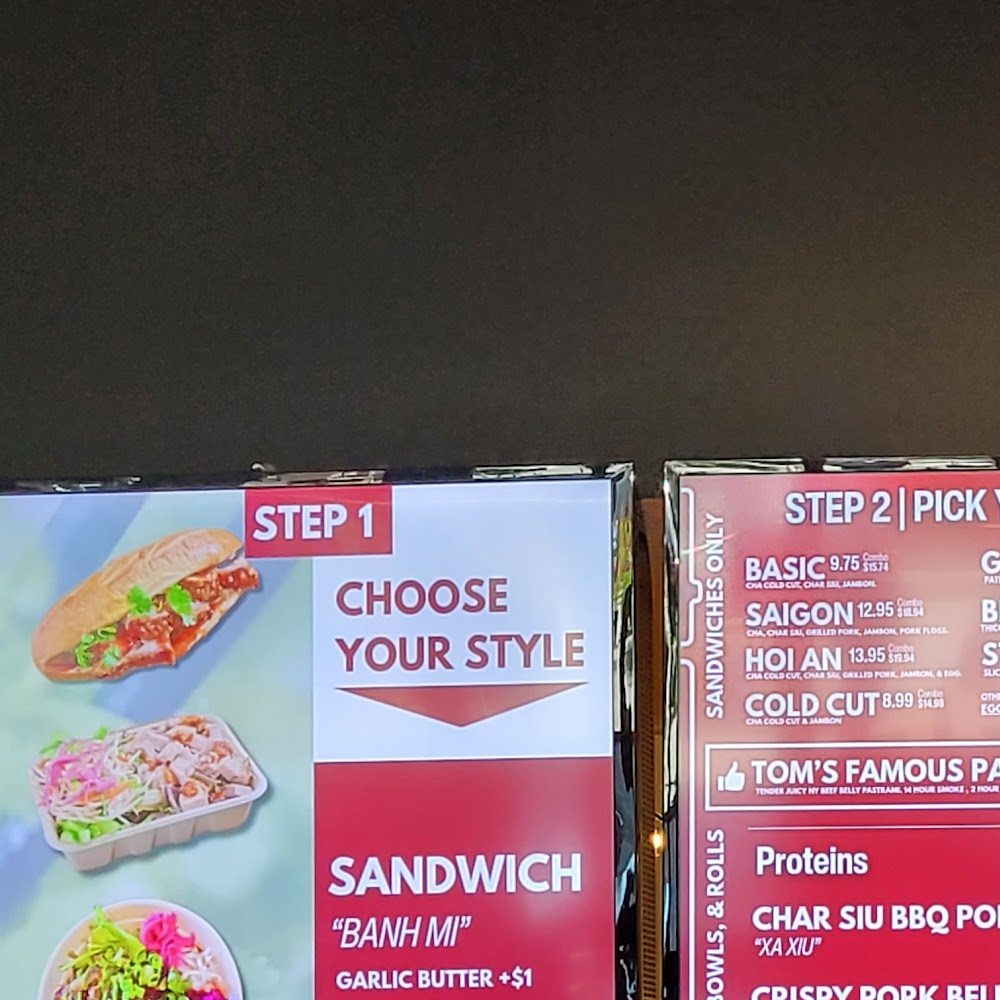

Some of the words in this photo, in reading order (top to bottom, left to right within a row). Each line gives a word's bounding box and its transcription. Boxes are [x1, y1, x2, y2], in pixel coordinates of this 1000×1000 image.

[253, 505, 349, 540] STEP
[358, 505, 375, 537] 1
[785, 489, 864, 525] STEP
[870, 490, 893, 523] 2
[912, 488, 987, 522] PICK
[705, 513, 724, 572] ONLY
[745, 556, 826, 581] BASIC
[829, 556, 860, 572] 9.75
[335, 578, 509, 617] CHOOSE
[745, 602, 854, 627] SAIGON
[858, 602, 894, 618] 12.95
[335, 636, 453, 672] YOUR
[466, 632, 585, 668] STYLE
[705, 579, 724, 719] SANDWICHES
[745, 648, 794, 673] HOI
[800, 647, 841, 671] AN
[849, 647, 886, 663] 13.95
[745, 693, 820, 717] COLD
[826, 692, 879, 716] CUT
[882, 693, 914, 708] 8.99
[751, 759, 839, 785] TOM'S
[845, 758, 963, 784] FAMOUS
[328, 854, 583, 898] SANDWICH
[755, 846, 869, 876] Proteins
[331, 916, 421, 950] “BANH
[425, 915, 472, 948] MI”
[752, 906, 832, 931] CHAR
[839, 906, 884, 930] SIU
[891, 905, 950, 934] BBQ
[335, 969, 413, 990] GARLIC
[416, 968, 494, 989] BUTTER
[498, 967, 533, 989] +$1
